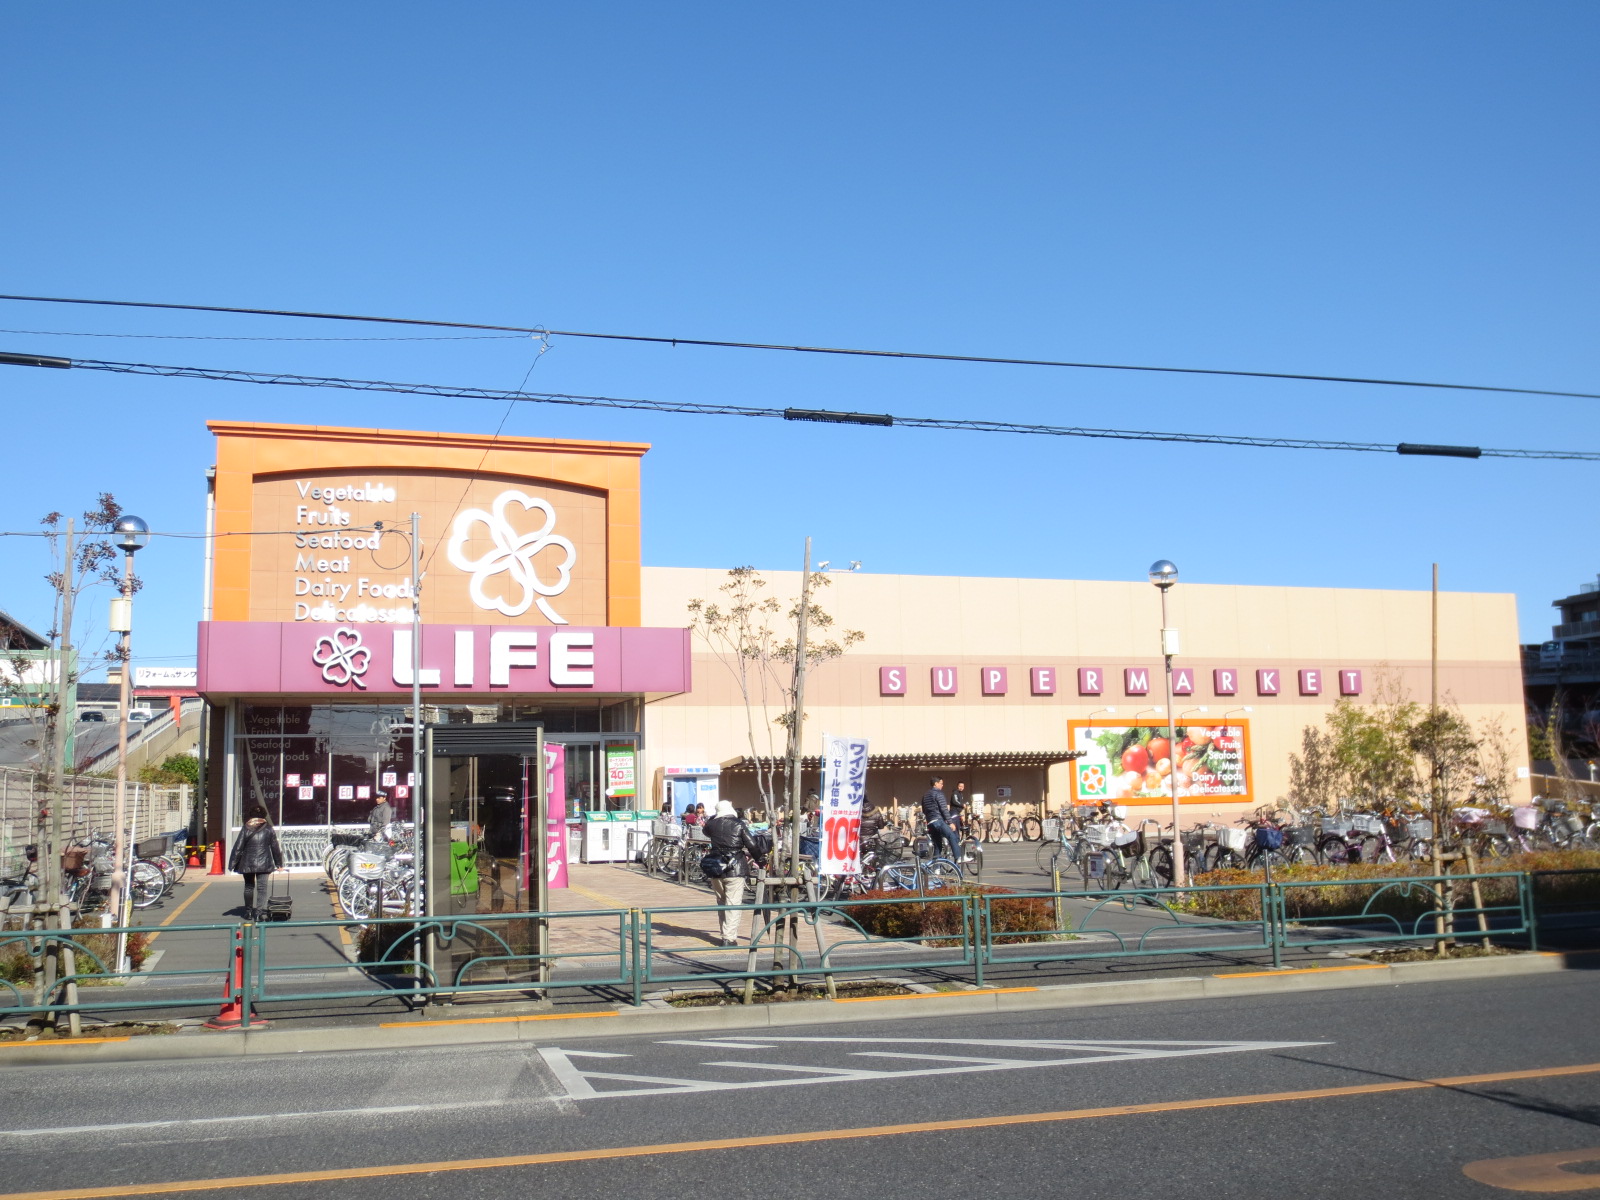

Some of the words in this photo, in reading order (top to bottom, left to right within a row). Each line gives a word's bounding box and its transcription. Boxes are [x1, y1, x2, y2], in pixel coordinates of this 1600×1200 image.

[296, 480, 396, 504] Vegetable
[296, 505, 350, 526] Fruits
[294, 530, 380, 550] Seafood
[294, 552, 350, 573] Meat
[295, 577, 351, 602] Dairy
[392, 629, 594, 687] LIFE
[1200, 727, 1241, 739] Vegetable
[1220, 740, 1242, 749] Fruits
[283, 750, 310, 761] oods
[1209, 750, 1243, 760] Seafood
[610, 770, 625, 780] 40
[847, 743, 866, 806] ワイシャツ
[1222, 761, 1243, 770] Meat
[830, 758, 842, 808] セール価格
[1192, 772, 1216, 784] Dairy
[1217, 770, 1243, 781] Foods
[824, 816, 861, 861] 105
[842, 862, 856, 873] えん
